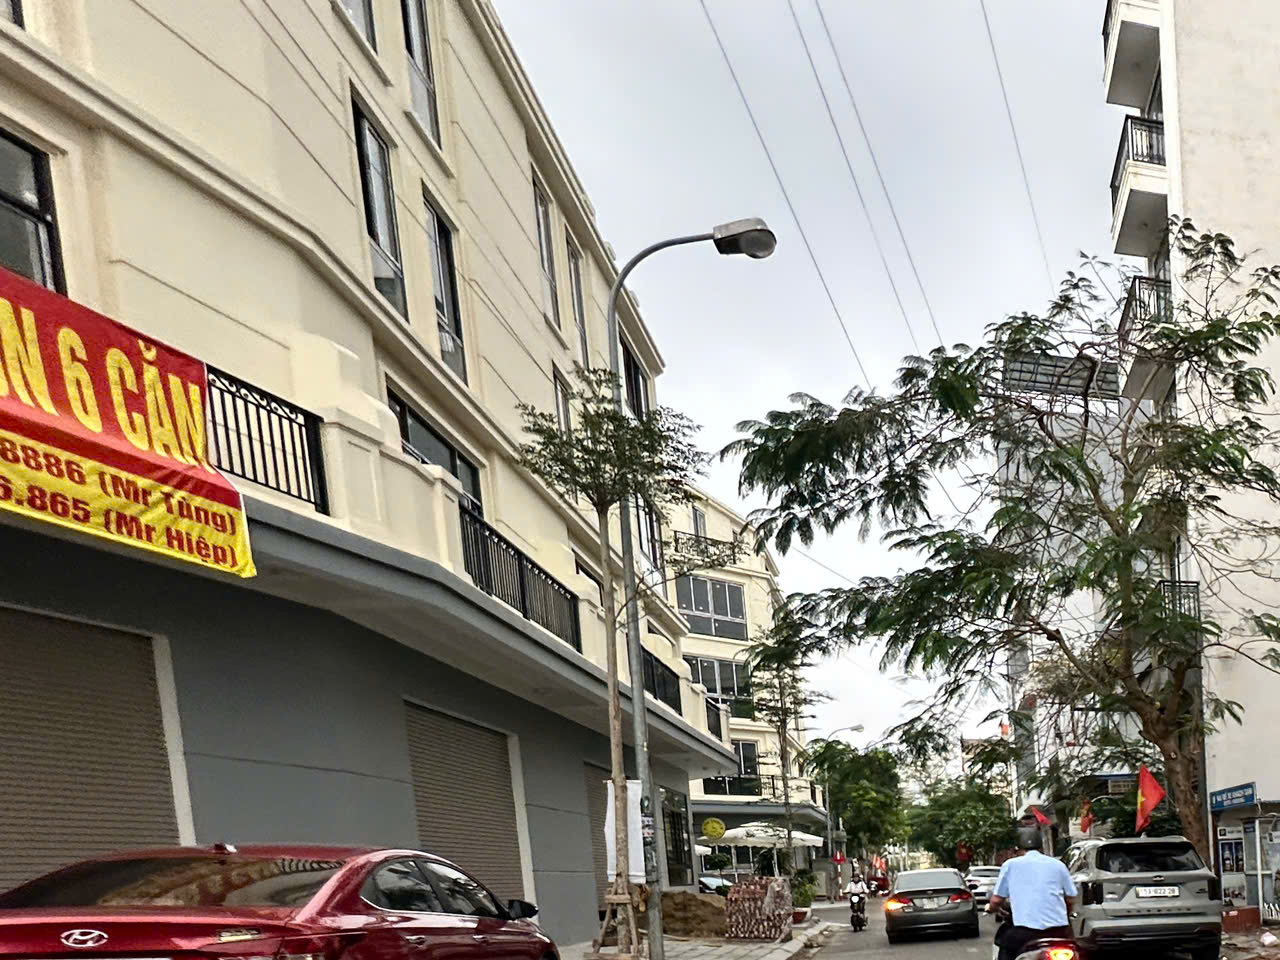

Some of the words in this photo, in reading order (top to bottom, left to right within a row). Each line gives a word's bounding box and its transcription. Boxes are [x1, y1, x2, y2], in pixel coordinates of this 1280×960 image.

[57, 326, 102, 433] 6
[106, 338, 216, 474] CĂN
[98, 471, 152, 507] (Mr
[162, 490, 236, 534] Tùng)
[104, 508, 156, 543] (Mr
[166, 527, 237, 568] Hiệp)
